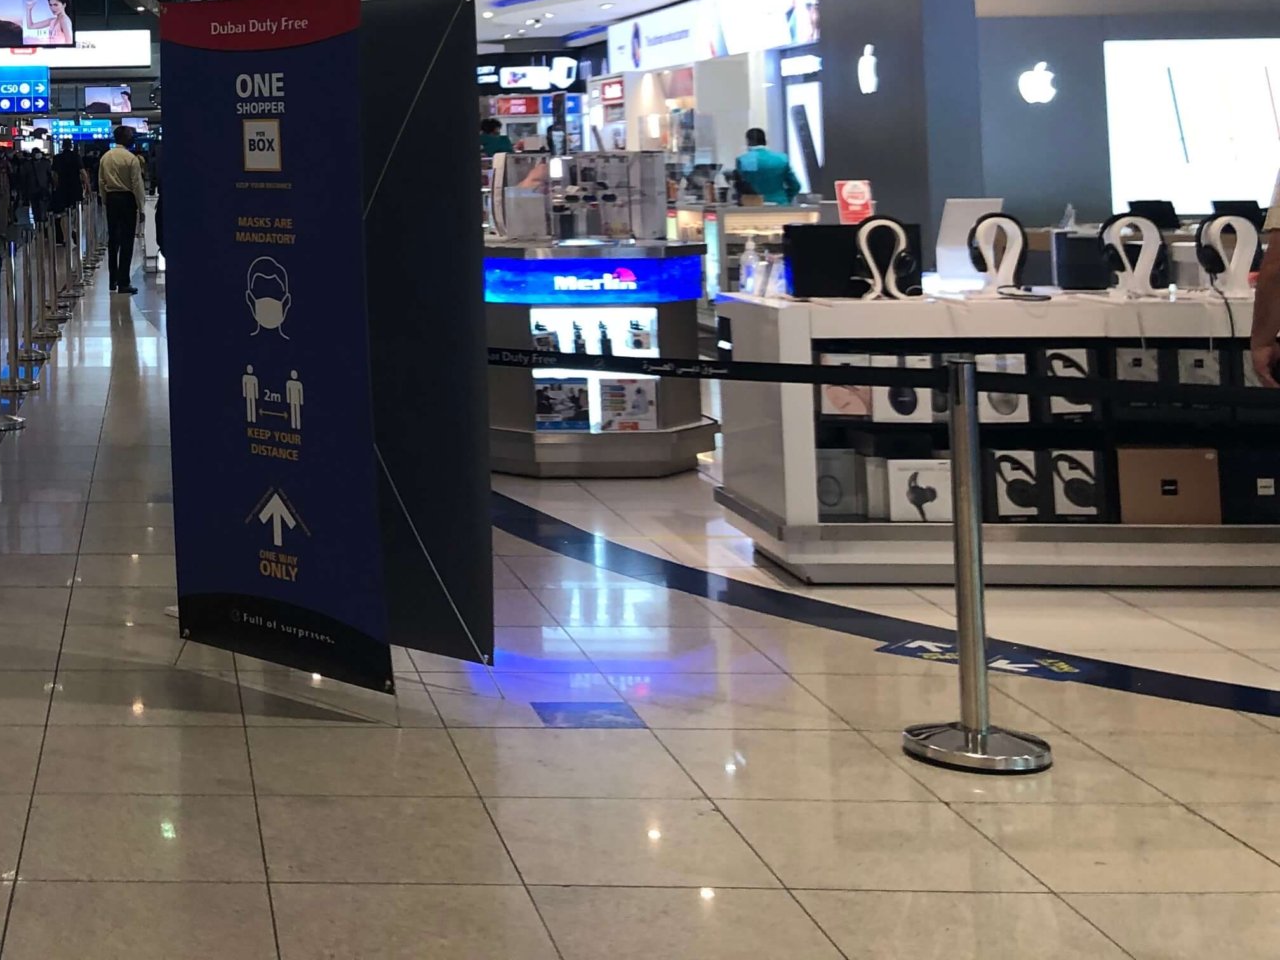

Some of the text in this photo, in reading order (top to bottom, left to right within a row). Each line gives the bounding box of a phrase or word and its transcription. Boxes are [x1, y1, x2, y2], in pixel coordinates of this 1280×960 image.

[210, 17, 308, 35] Dubai Duty Free
[236, 72, 285, 98] ONE
[236, 102, 285, 114] SHOPPER
[248, 139, 275, 152] BOX
[238, 217, 293, 229] MASKS ARE
[236, 231, 296, 244] MANDATORY
[532, 353, 558, 365] Free
[264, 389, 281, 403] 2m
[247, 427, 302, 445] KEEP YOUR
[251, 444, 299, 461] DISTANCE
[259, 561, 298, 582] ONLY
[243, 612, 263, 626] Full
[266, 619, 277, 629] of
